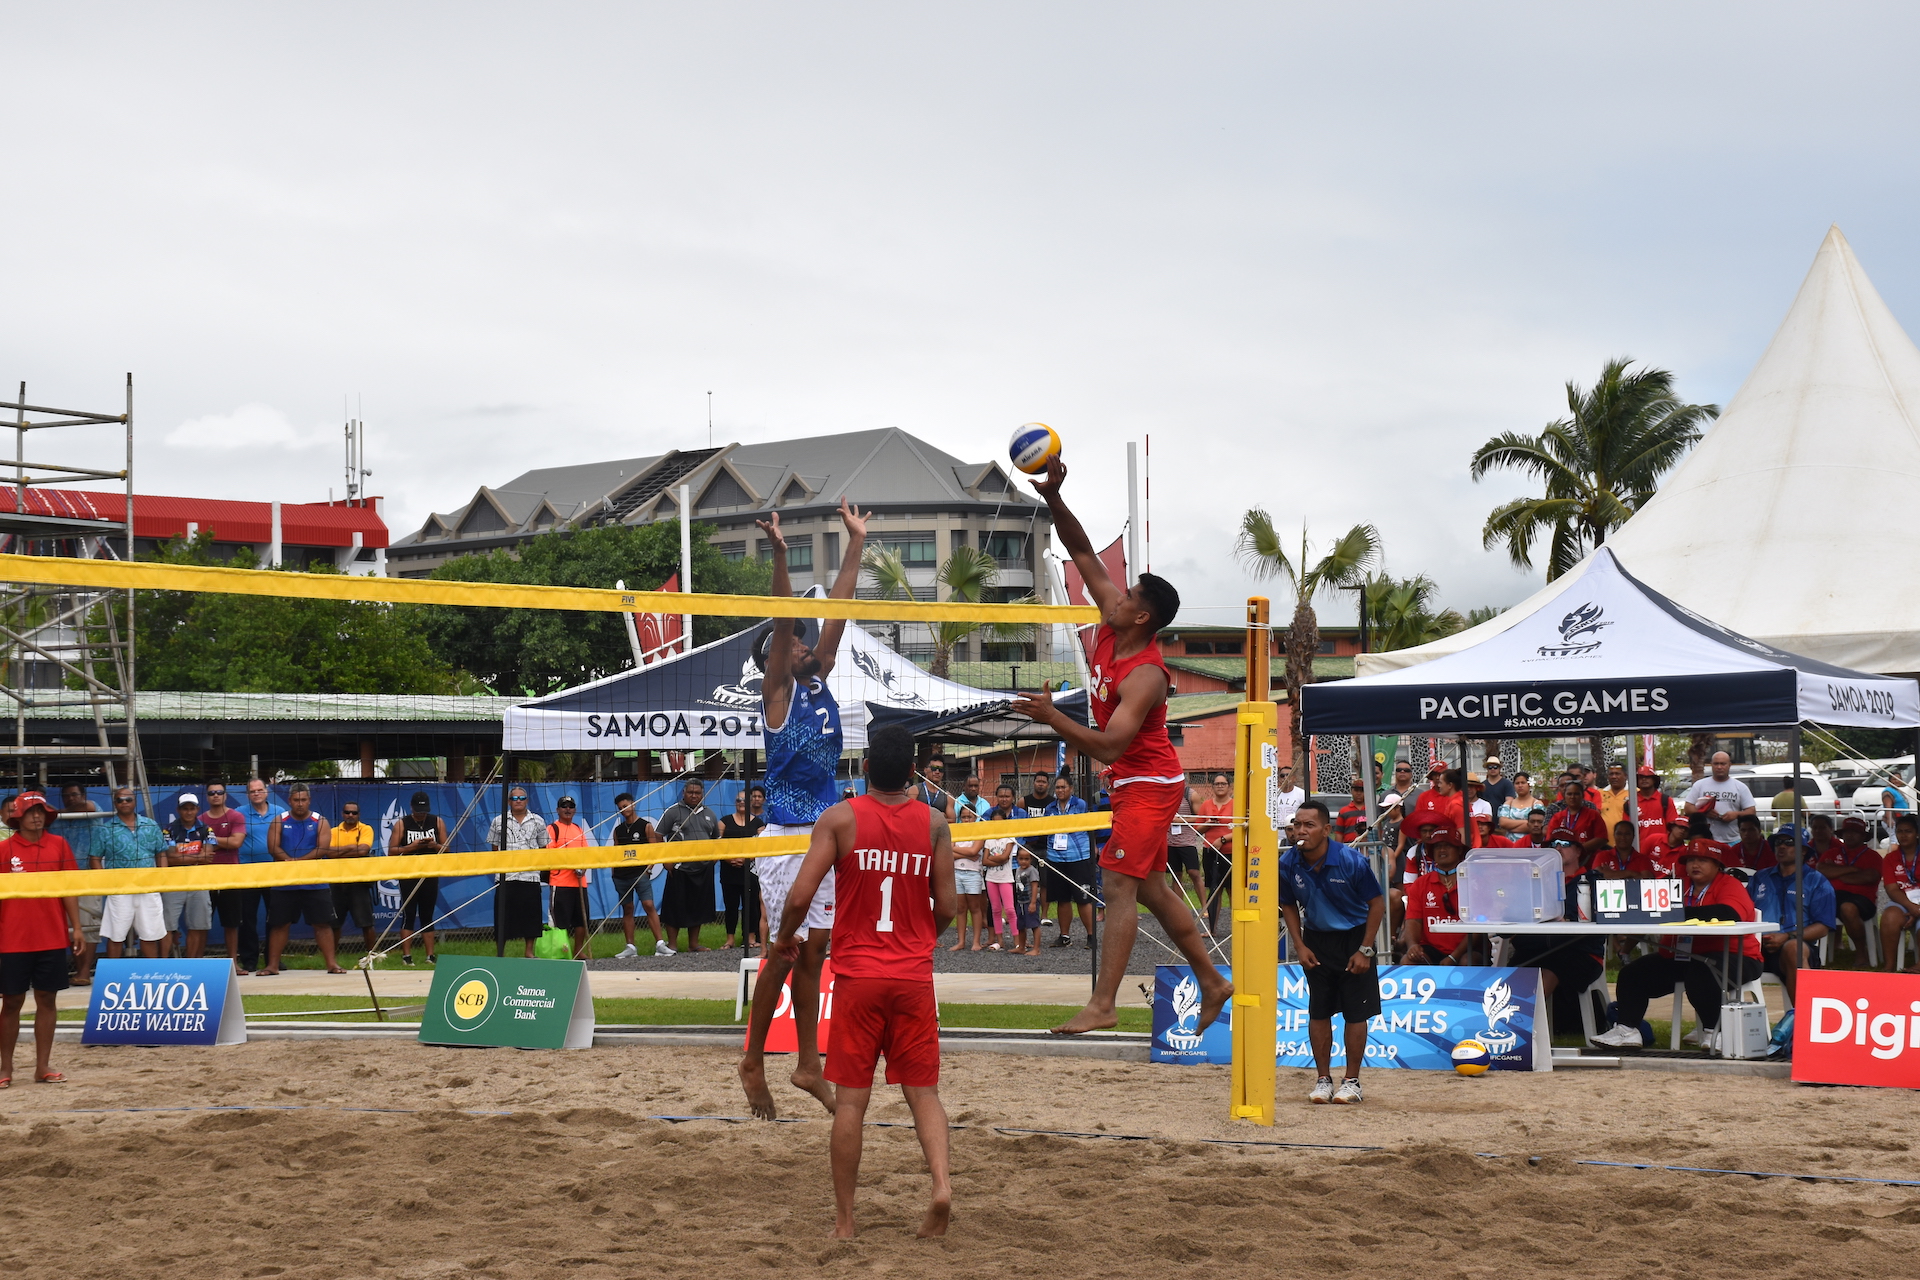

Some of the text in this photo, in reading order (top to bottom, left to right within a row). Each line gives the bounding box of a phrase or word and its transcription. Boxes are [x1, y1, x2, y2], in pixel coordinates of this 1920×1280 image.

[1420, 687, 1670, 720] PACIFIC GAMES
[1827, 684, 1896, 720] SAMOA 2019
[587, 712, 762, 738] SAMOA 201
[815, 707, 835, 735] 2
[1504, 717, 1584, 728] #SAMOA2019
[1638, 817, 1663, 828] igicel
[854, 848, 932, 877] TAHITI
[1599, 888, 1669, 908] 17 18
[1673, 883, 1680, 898] 1
[876, 875, 893, 932] 1
[100, 982, 209, 1011] SAMOA
[457, 993, 485, 1006] SCB
[503, 996, 556, 1009] Commercial
[517, 985, 546, 997] Samoa
[1379, 978, 1437, 1005] 019
[96, 1013, 206, 1032] PURE WATER
[514, 1009, 537, 1020] Bank
[1367, 1010, 1448, 1033] AMES
[1809, 997, 1920, 1060] Digi
